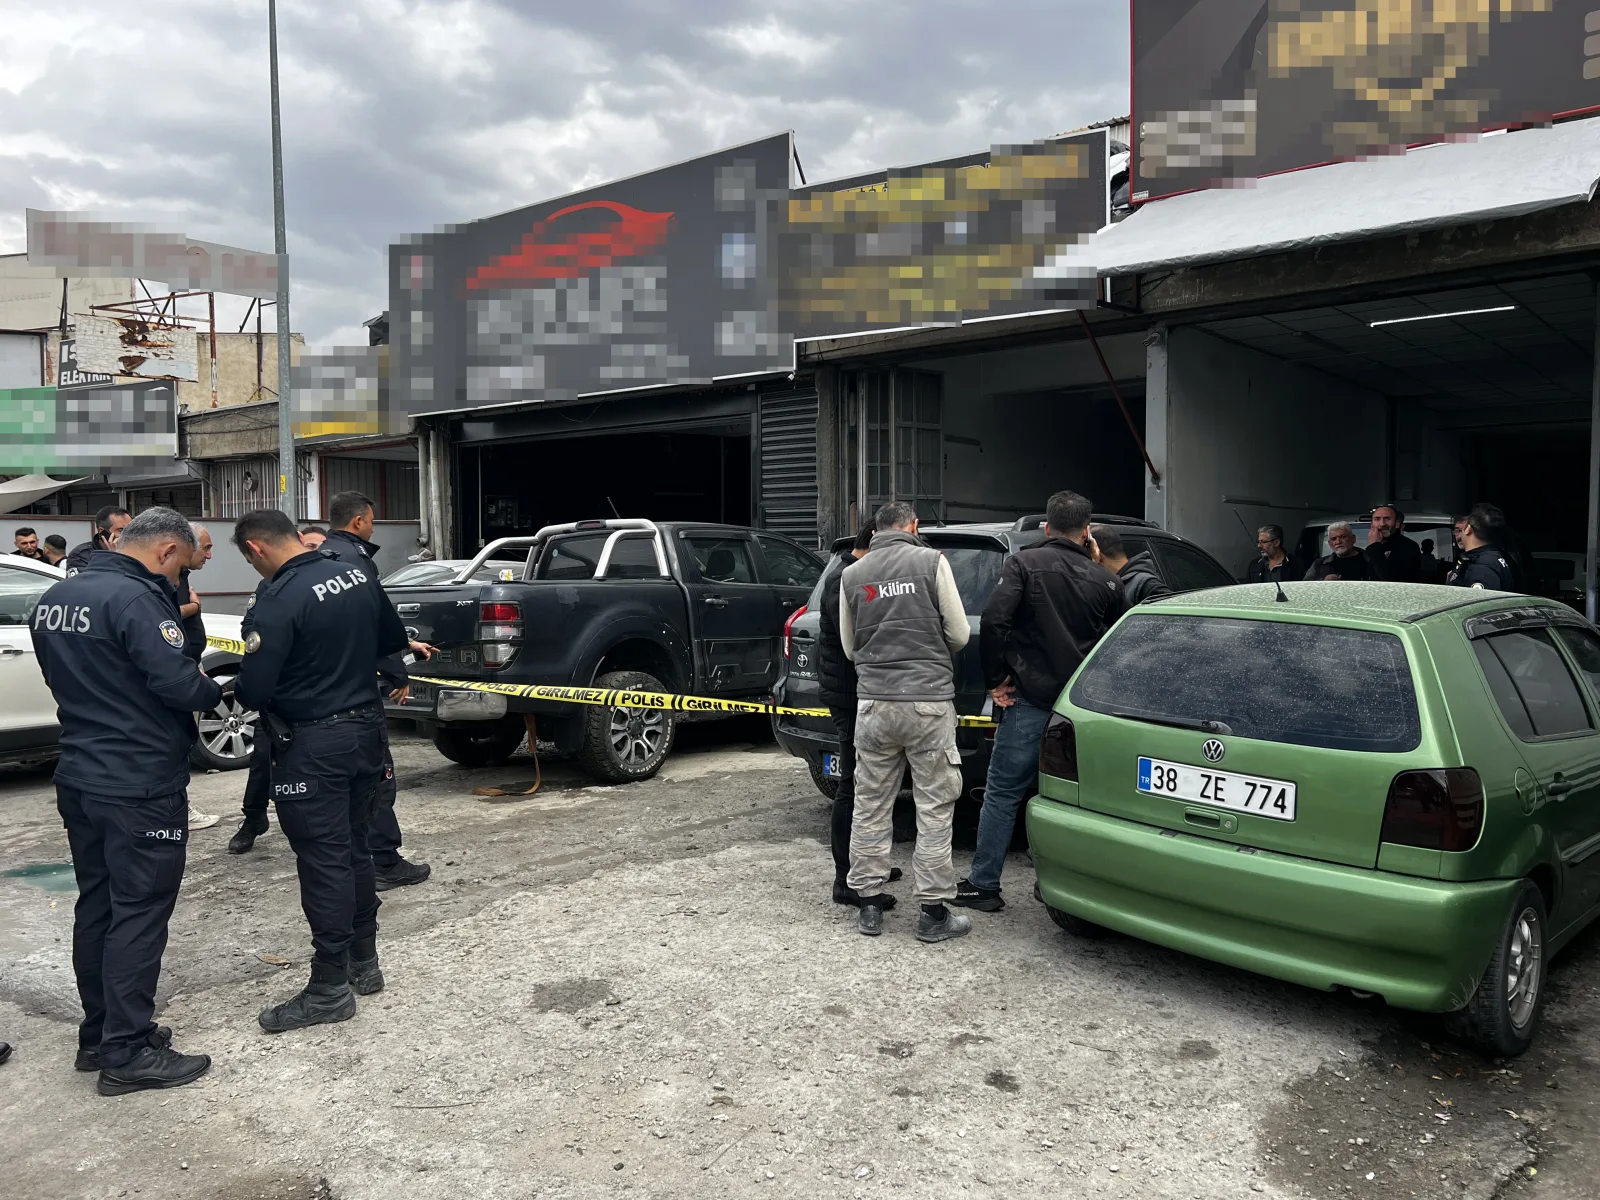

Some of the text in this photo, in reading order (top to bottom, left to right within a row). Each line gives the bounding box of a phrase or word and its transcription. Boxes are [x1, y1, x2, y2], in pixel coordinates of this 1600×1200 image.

[879, 581, 916, 598] kilim
[1141, 765, 1287, 814] TR 38 ZE 774
